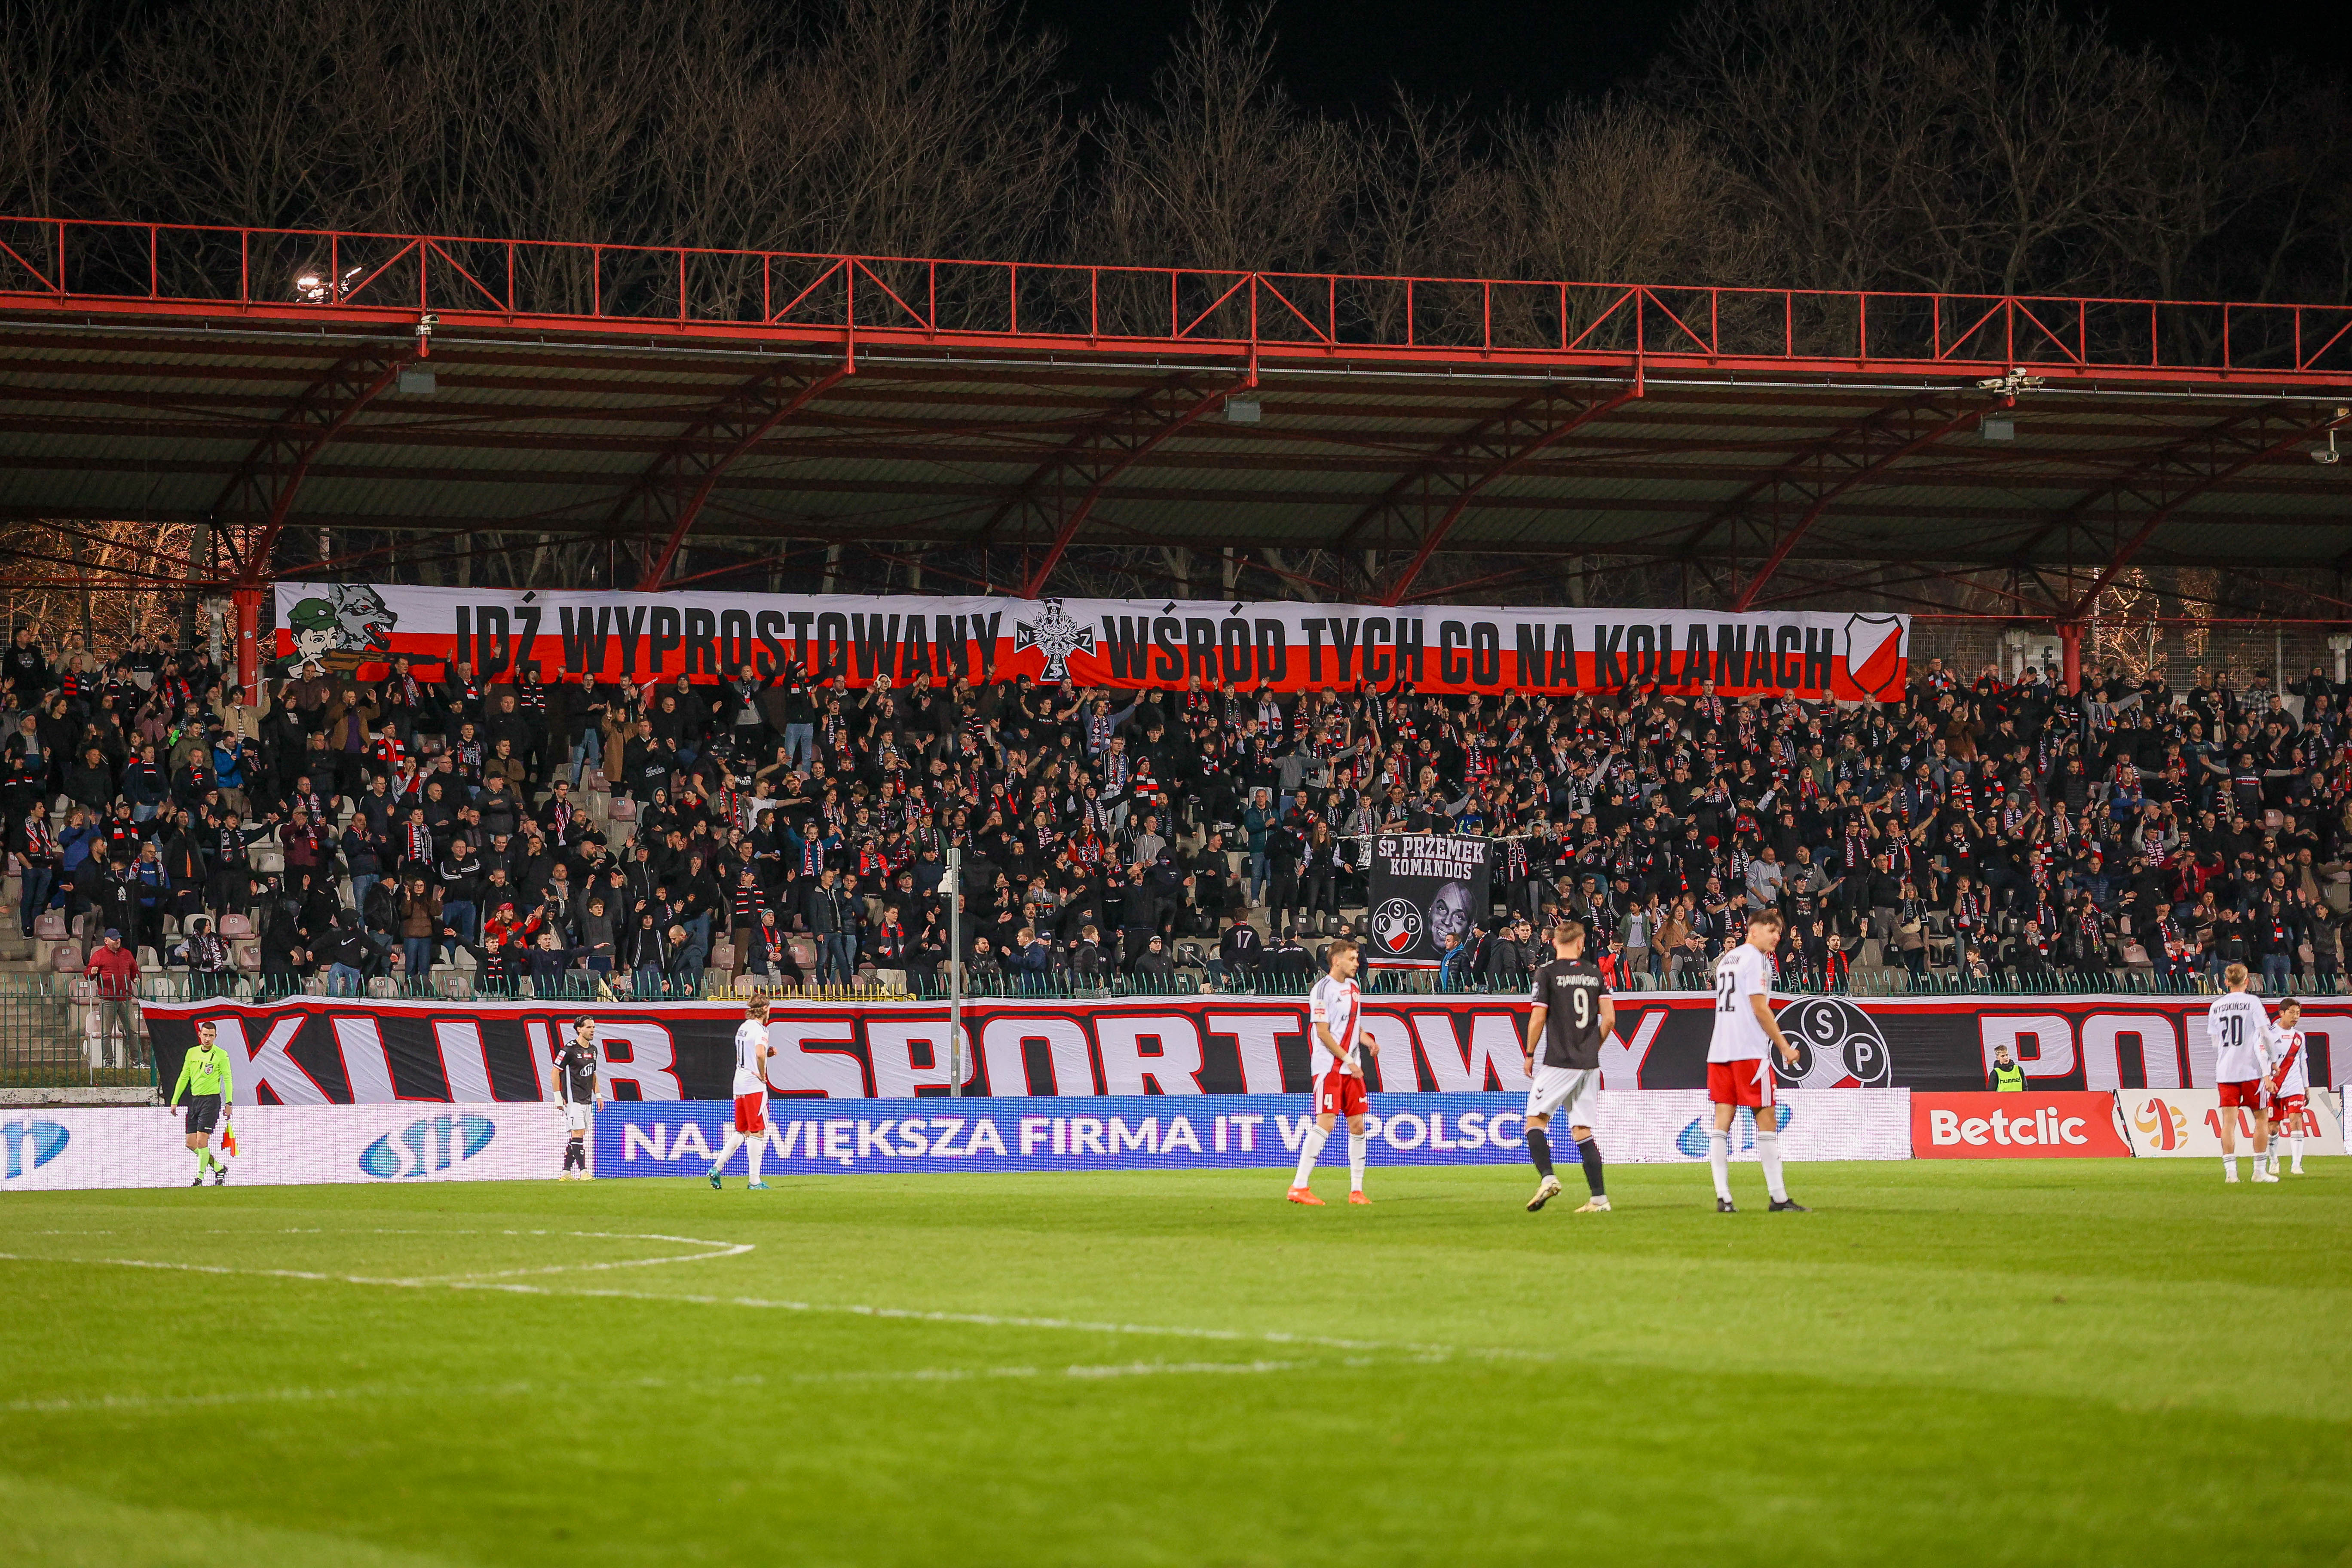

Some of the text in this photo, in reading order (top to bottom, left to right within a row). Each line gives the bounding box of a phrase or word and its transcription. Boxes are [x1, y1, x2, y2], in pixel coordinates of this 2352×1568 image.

[456, 591, 1834, 689] IDŹ WYPROSTOWANY WŚRÓD TYCH CO NA KOLANACH
[1378, 836, 1485, 864] ŚP. PRZEMEK
[1390, 858, 1472, 880] KOMANDOS
[1379, 904, 1416, 930] K S P
[1236, 931, 1253, 949] 17
[1770, 955, 1779, 981] POLONIA
[1718, 972, 1735, 1011] 22
[1573, 988, 1589, 1029] 9
[2213, 1002, 2250, 1014] WYSOKIŃSKI
[1816, 1009, 1834, 1039] S
[1854, 1043, 1872, 1072] P
[2219, 1015, 2243, 1047] 20
[1324, 1093, 1333, 1109] 4
[625, 1118, 1007, 1166] NAJWIĘKSZA
[1020, 1116, 1202, 1155] FIRMA
[1214, 1115, 1264, 1152] IT
[1360, 1112, 1553, 1150] POLSC
[1930, 1106, 2089, 1146] Betclic
